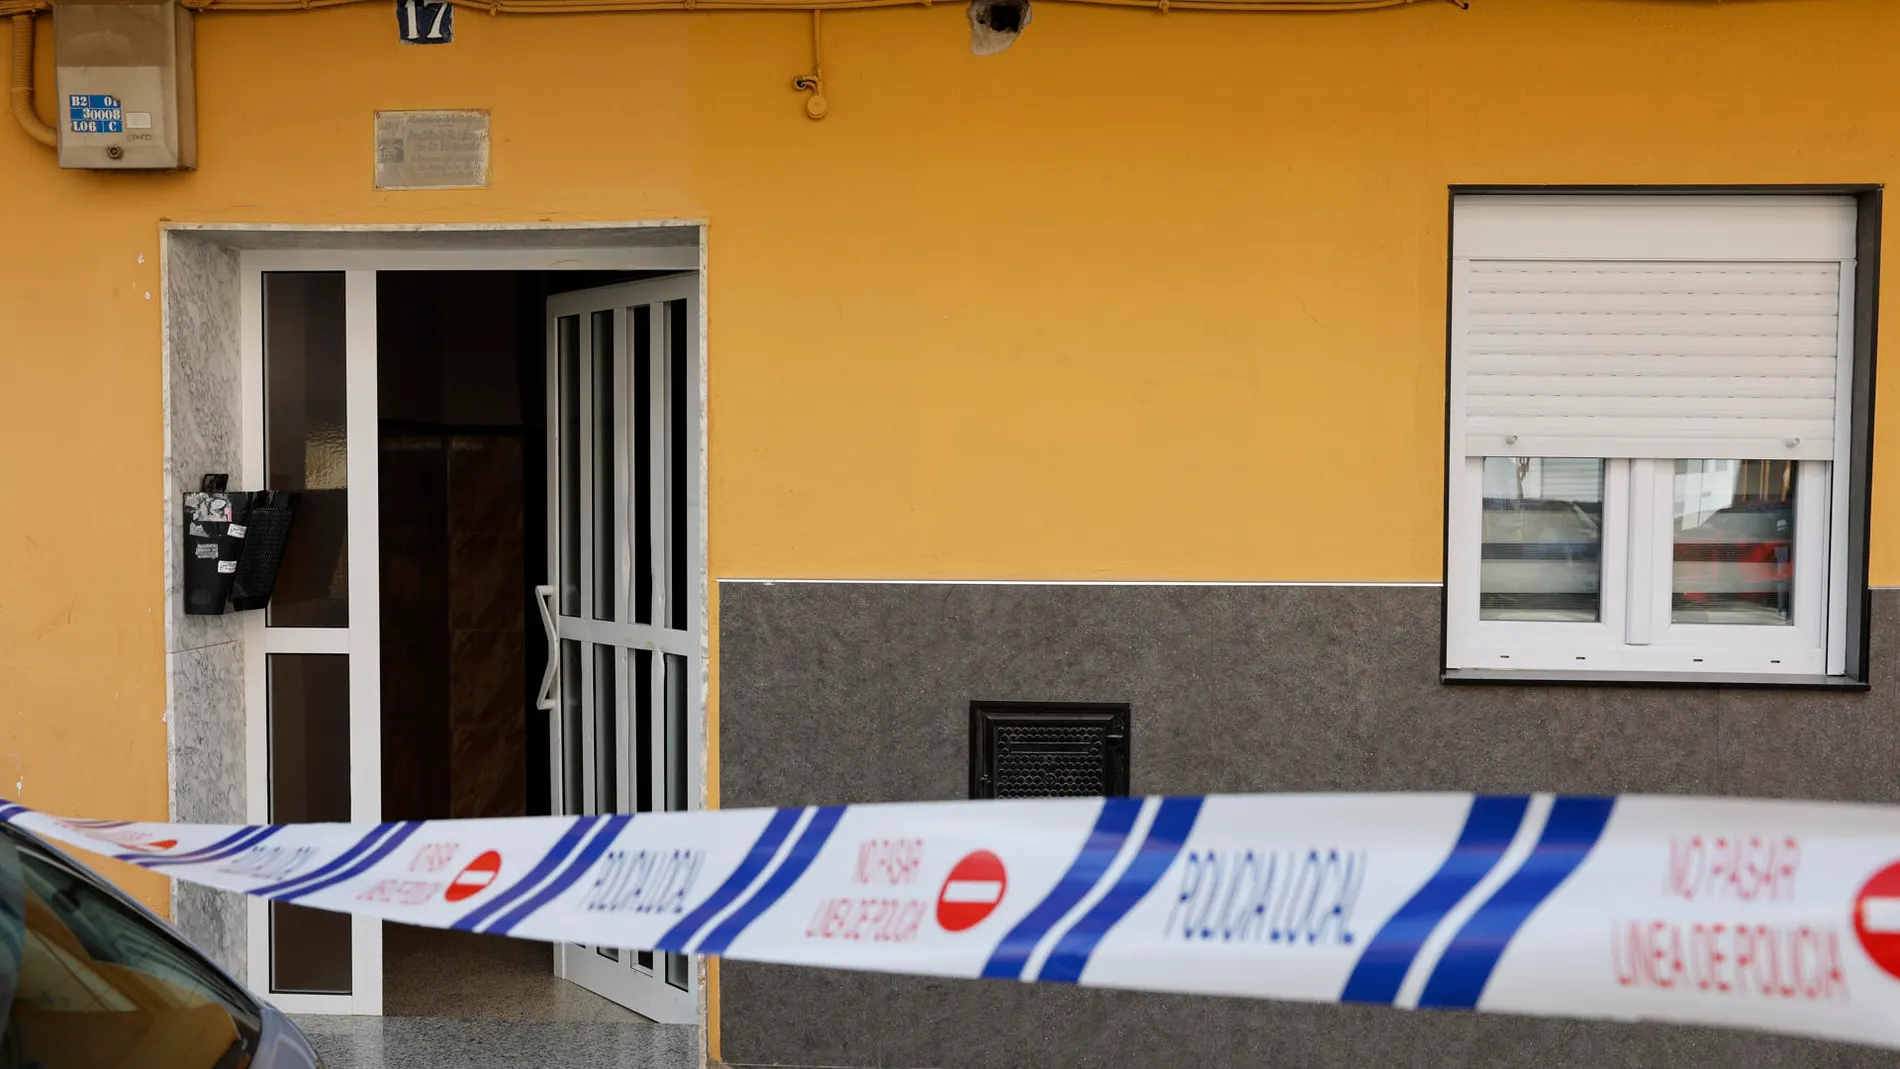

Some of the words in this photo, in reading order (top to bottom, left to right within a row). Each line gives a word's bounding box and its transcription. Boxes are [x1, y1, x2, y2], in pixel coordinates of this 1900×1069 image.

[404, 0, 447, 39] 17
[71, 96, 88, 107] B2
[83, 108, 121, 120] 30008
[108, 121, 117, 131] C
[1704, 836, 1802, 904] PASAR
